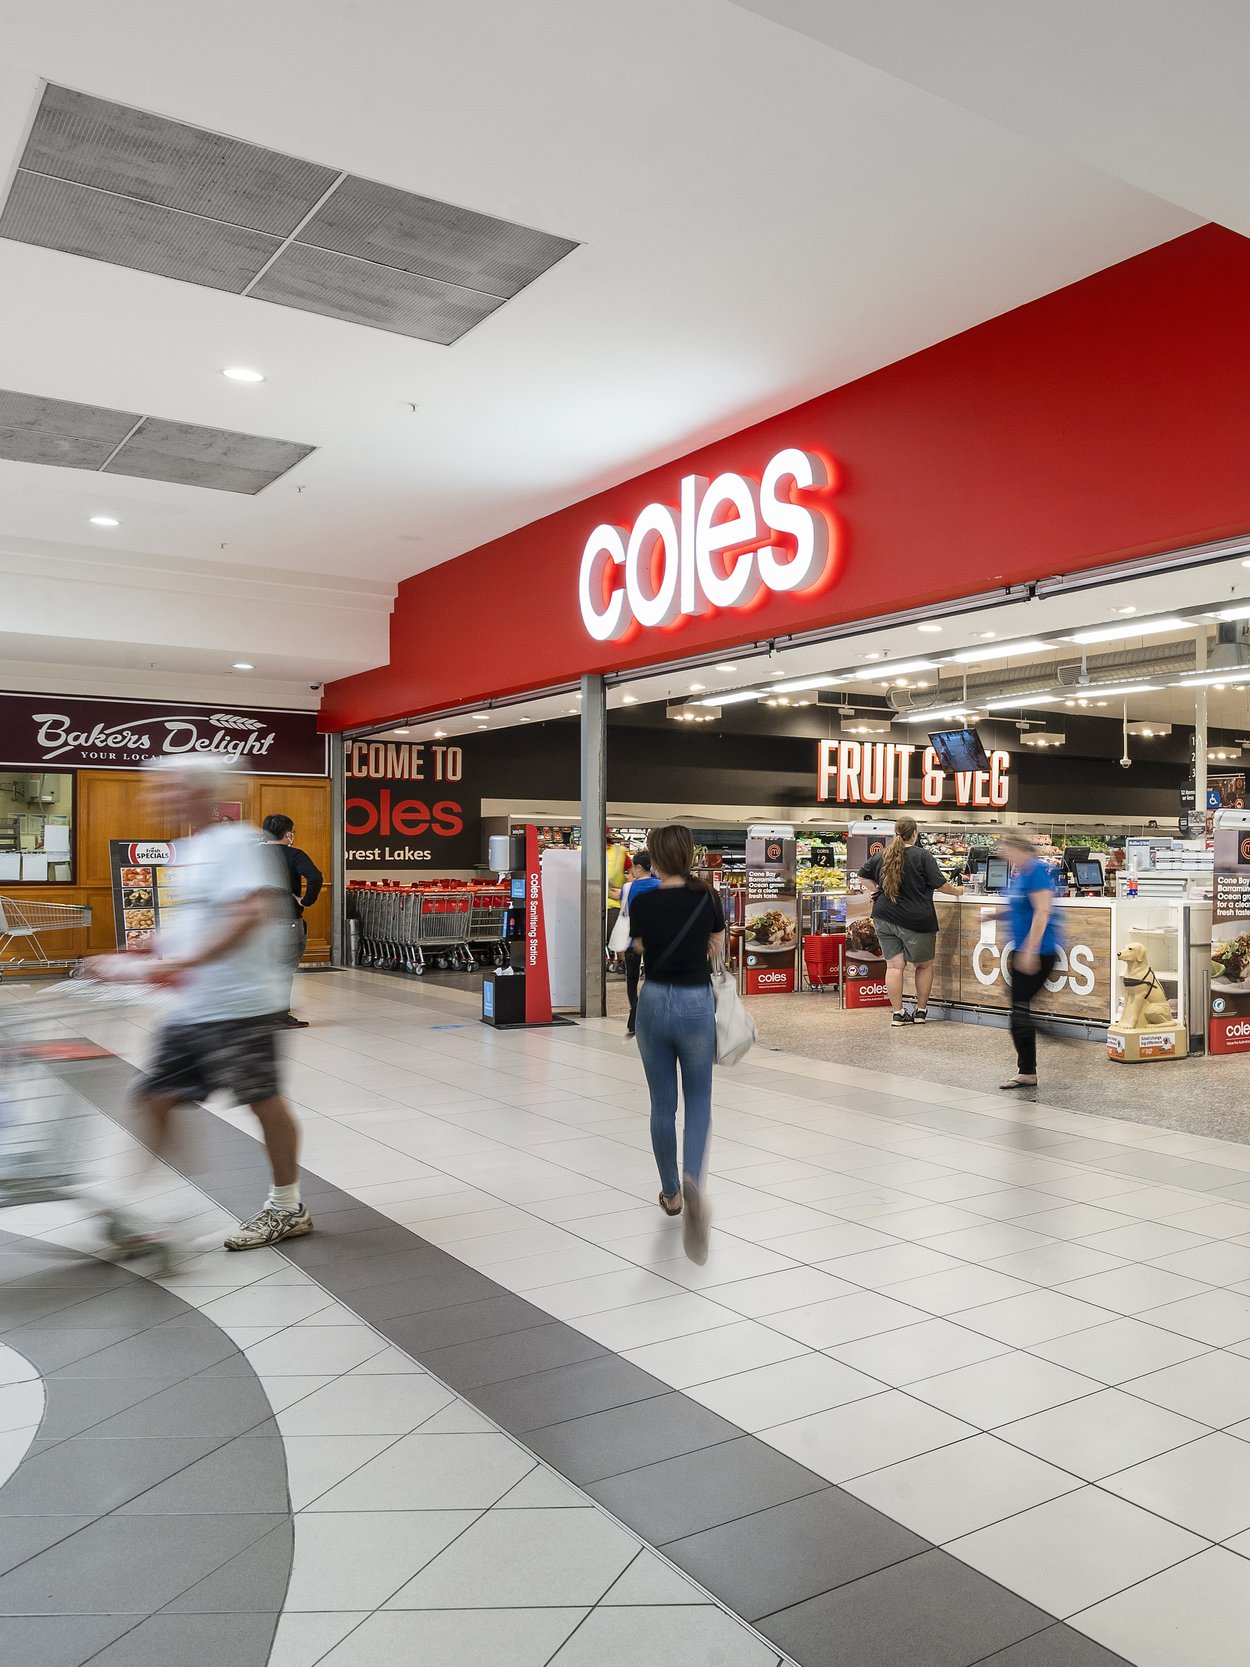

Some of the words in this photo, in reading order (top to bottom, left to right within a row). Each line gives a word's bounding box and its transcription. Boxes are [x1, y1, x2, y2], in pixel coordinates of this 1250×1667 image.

[579, 448, 827, 640] coles
[32, 713, 151, 760] Bakers
[162, 721, 276, 764] Delight
[81, 751, 117, 760] YOUR
[345, 741, 425, 780] COME
[431, 745, 463, 782] TO
[817, 739, 915, 805] FRUIT
[922, 746, 946, 805] &
[346, 788, 464, 837] oles
[385, 846, 432, 860] Lakes
[530, 873, 540, 899] coles
[1217, 876, 1238, 884] Cone
[1238, 877, 1250, 885] Bay
[1217, 892, 1241, 900] Ocean
[1217, 908, 1234, 916] fresh
[529, 939, 538, 966] Station
[758, 972, 787, 983] coles
[972, 941, 1096, 996] coes
[859, 983, 888, 995] coles
